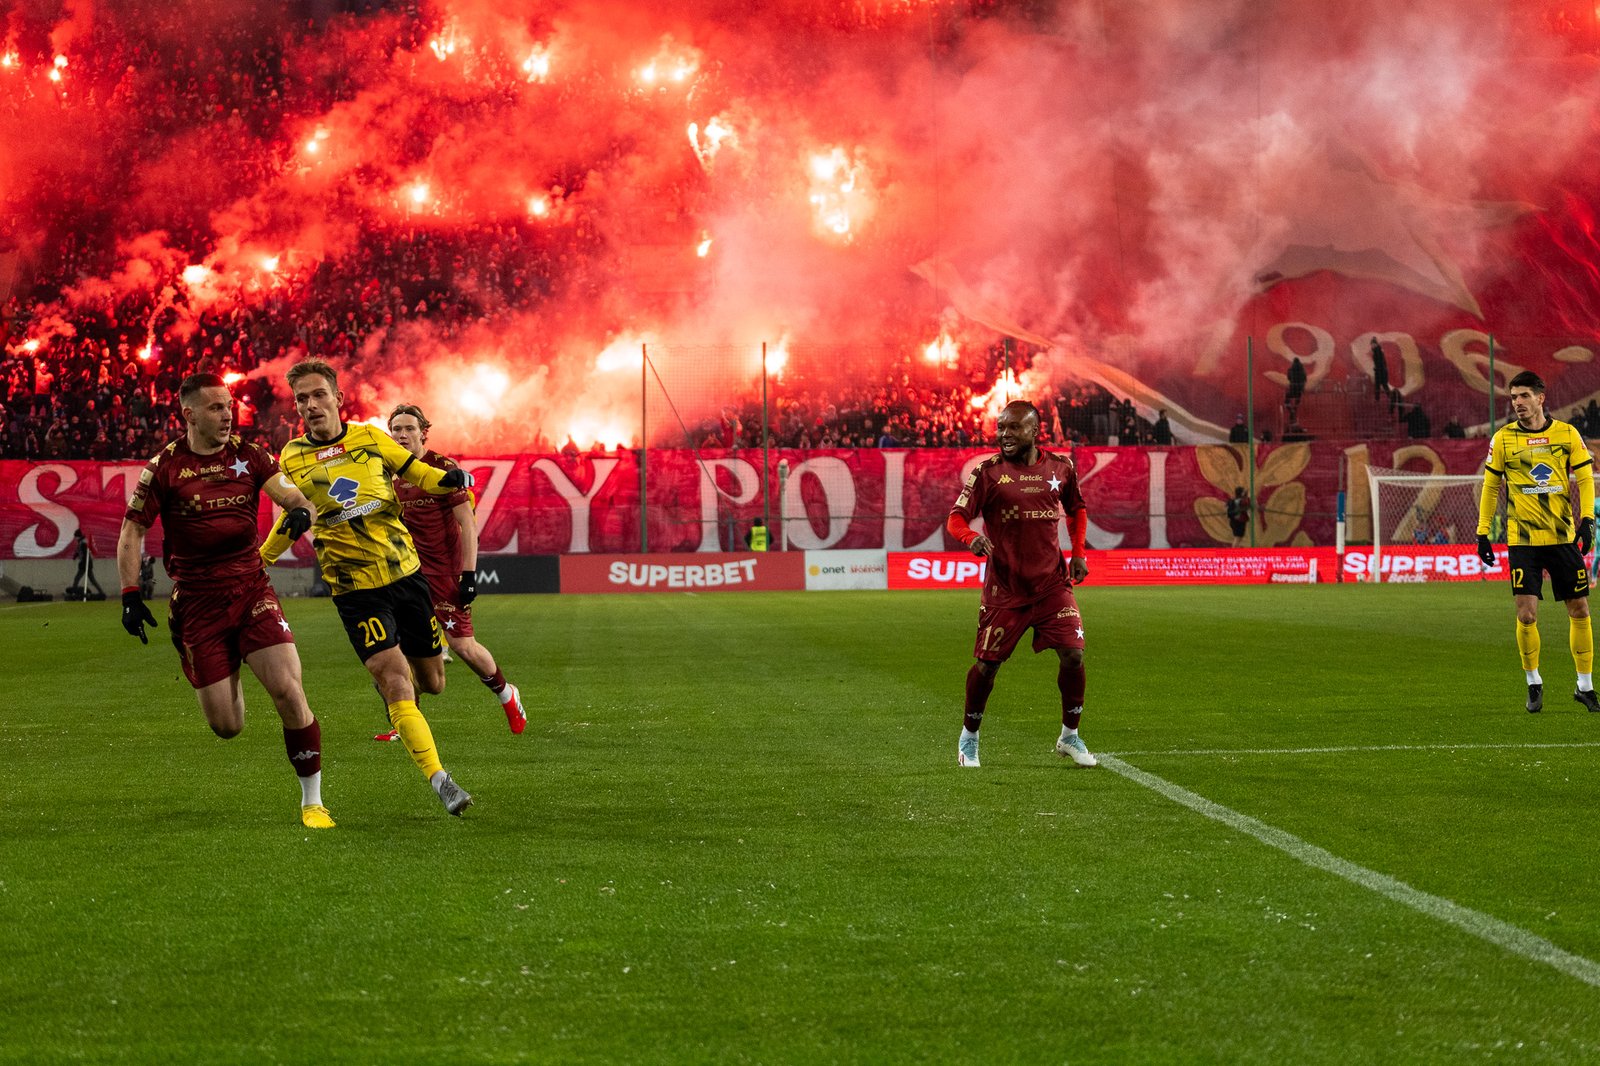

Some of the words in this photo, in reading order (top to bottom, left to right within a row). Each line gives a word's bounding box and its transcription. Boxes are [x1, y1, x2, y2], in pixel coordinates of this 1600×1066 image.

[200, 464, 225, 474] Betclic
[326, 500, 381, 526] zondacrypto
[608, 558, 757, 588] SUPERBET
[822, 566, 846, 574] onet
[1511, 568, 1524, 588] 12
[357, 616, 387, 648] 20
[981, 625, 1005, 652] 12
